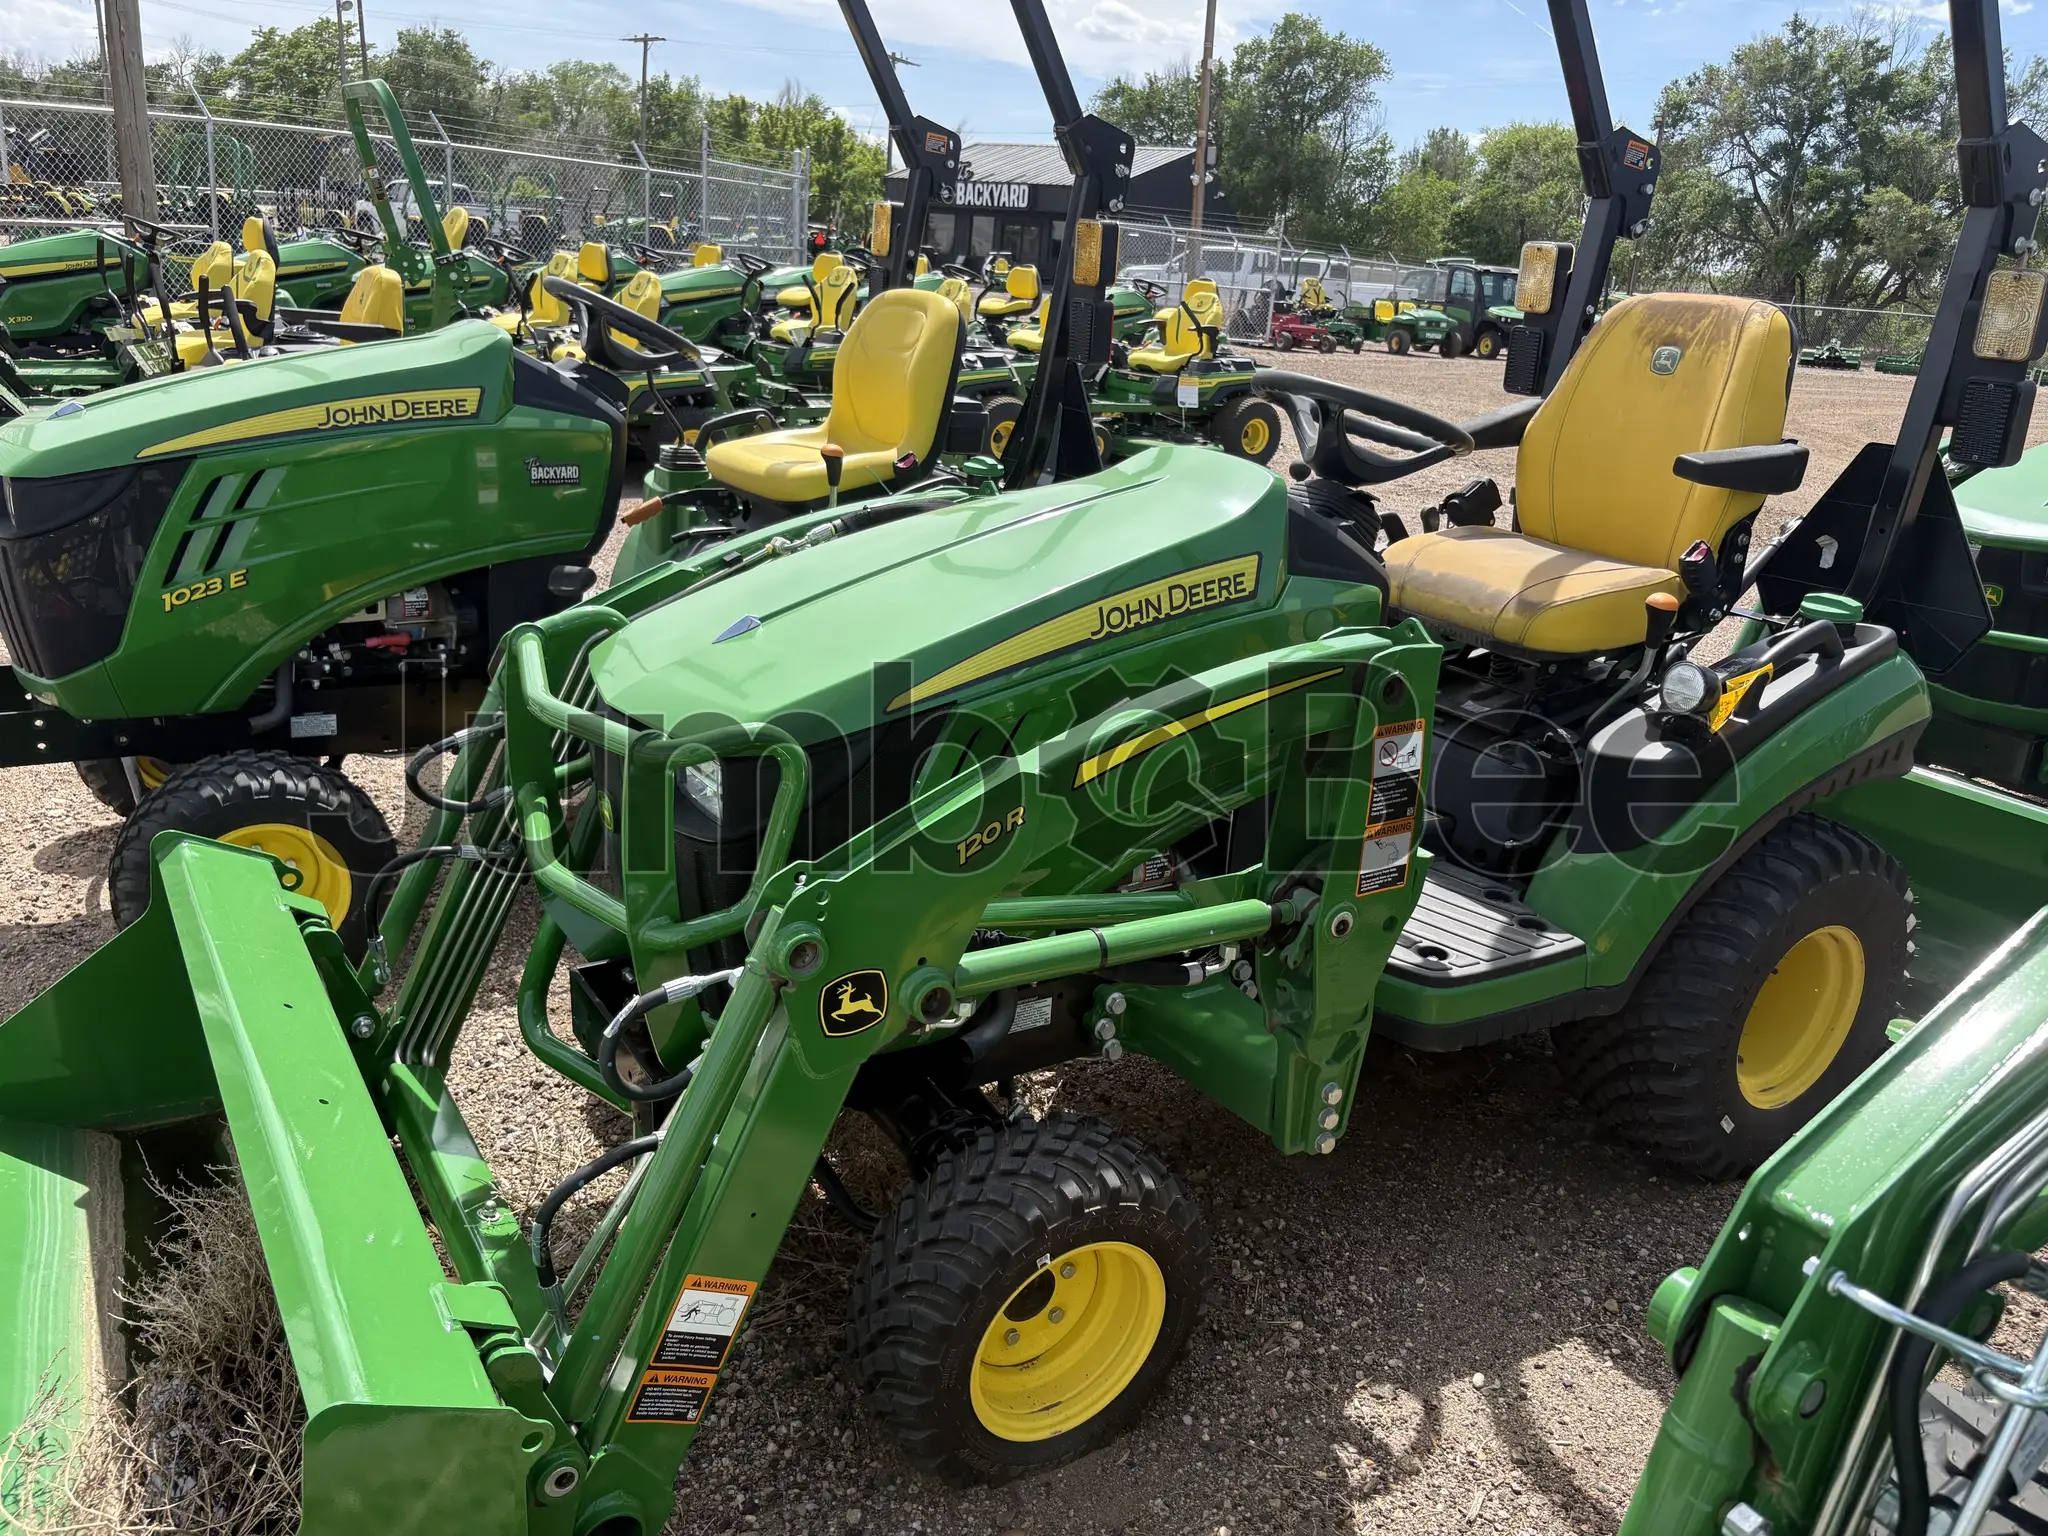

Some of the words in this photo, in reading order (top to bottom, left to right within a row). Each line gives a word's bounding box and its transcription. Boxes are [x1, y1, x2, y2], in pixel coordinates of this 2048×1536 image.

[956, 182, 1029, 208] BACKYARD
[8, 315, 32, 324] X330
[318, 404, 386, 427] JOHN
[391, 399, 469, 419] DEERE
[531, 466, 579, 480] BACKYARD
[162, 577, 223, 612] 1023
[230, 568, 247, 589] E
[1090, 594, 1163, 637] JOHN
[1168, 572, 1247, 612] DEERE
[1384, 721, 1423, 736] WARNING
[957, 821, 1002, 865] 120
[1006, 806, 1024, 832] R
[1374, 822, 1412, 837] WARNING
[704, 1280, 748, 1293] WARNING
[664, 1374, 708, 1385] WARNING
